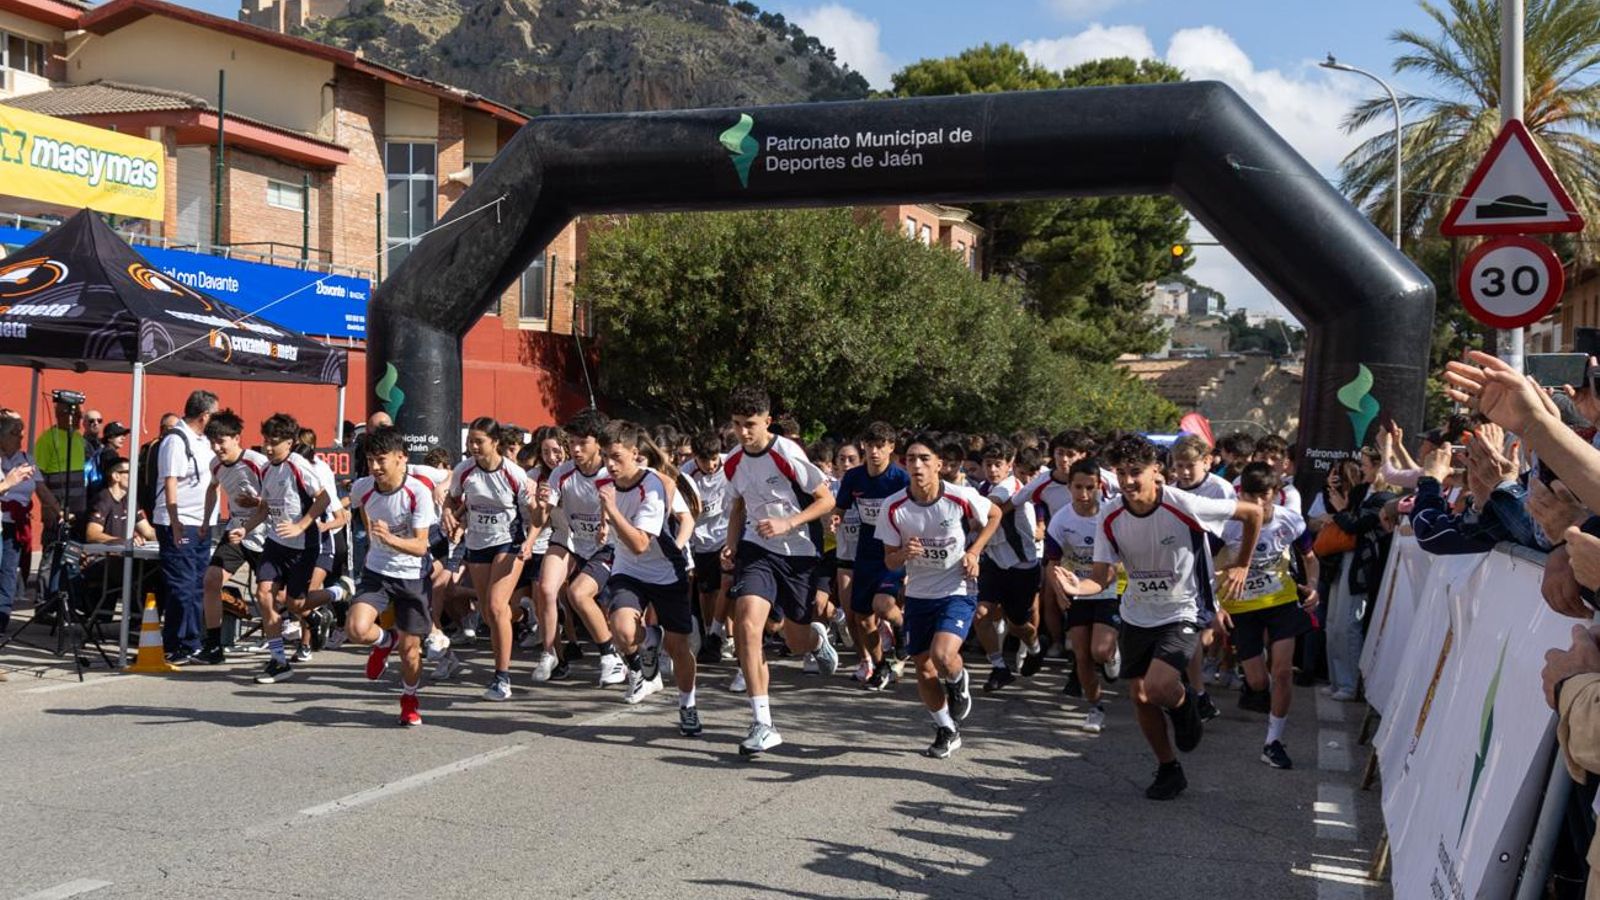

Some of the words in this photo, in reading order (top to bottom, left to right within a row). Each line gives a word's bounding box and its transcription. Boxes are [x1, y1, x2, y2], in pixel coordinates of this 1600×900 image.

[766, 136, 850, 151] Patronato
[856, 128, 943, 148] Municipal
[948, 127, 973, 143] de
[30, 135, 158, 190] masymas
[766, 155, 846, 174] Deportes
[850, 153, 874, 168] de
[879, 149, 923, 167] Jaén
[177, 271, 197, 287] con
[198, 271, 239, 293] Davante
[1480, 265, 1540, 297] 30
[428, 435, 439, 443] de
[407, 443, 429, 452] Jaén
[1305, 448, 1349, 458] Patronato
[478, 514, 498, 524] 276
[922, 548, 948, 559] 339
[1137, 580, 1168, 592] 344
